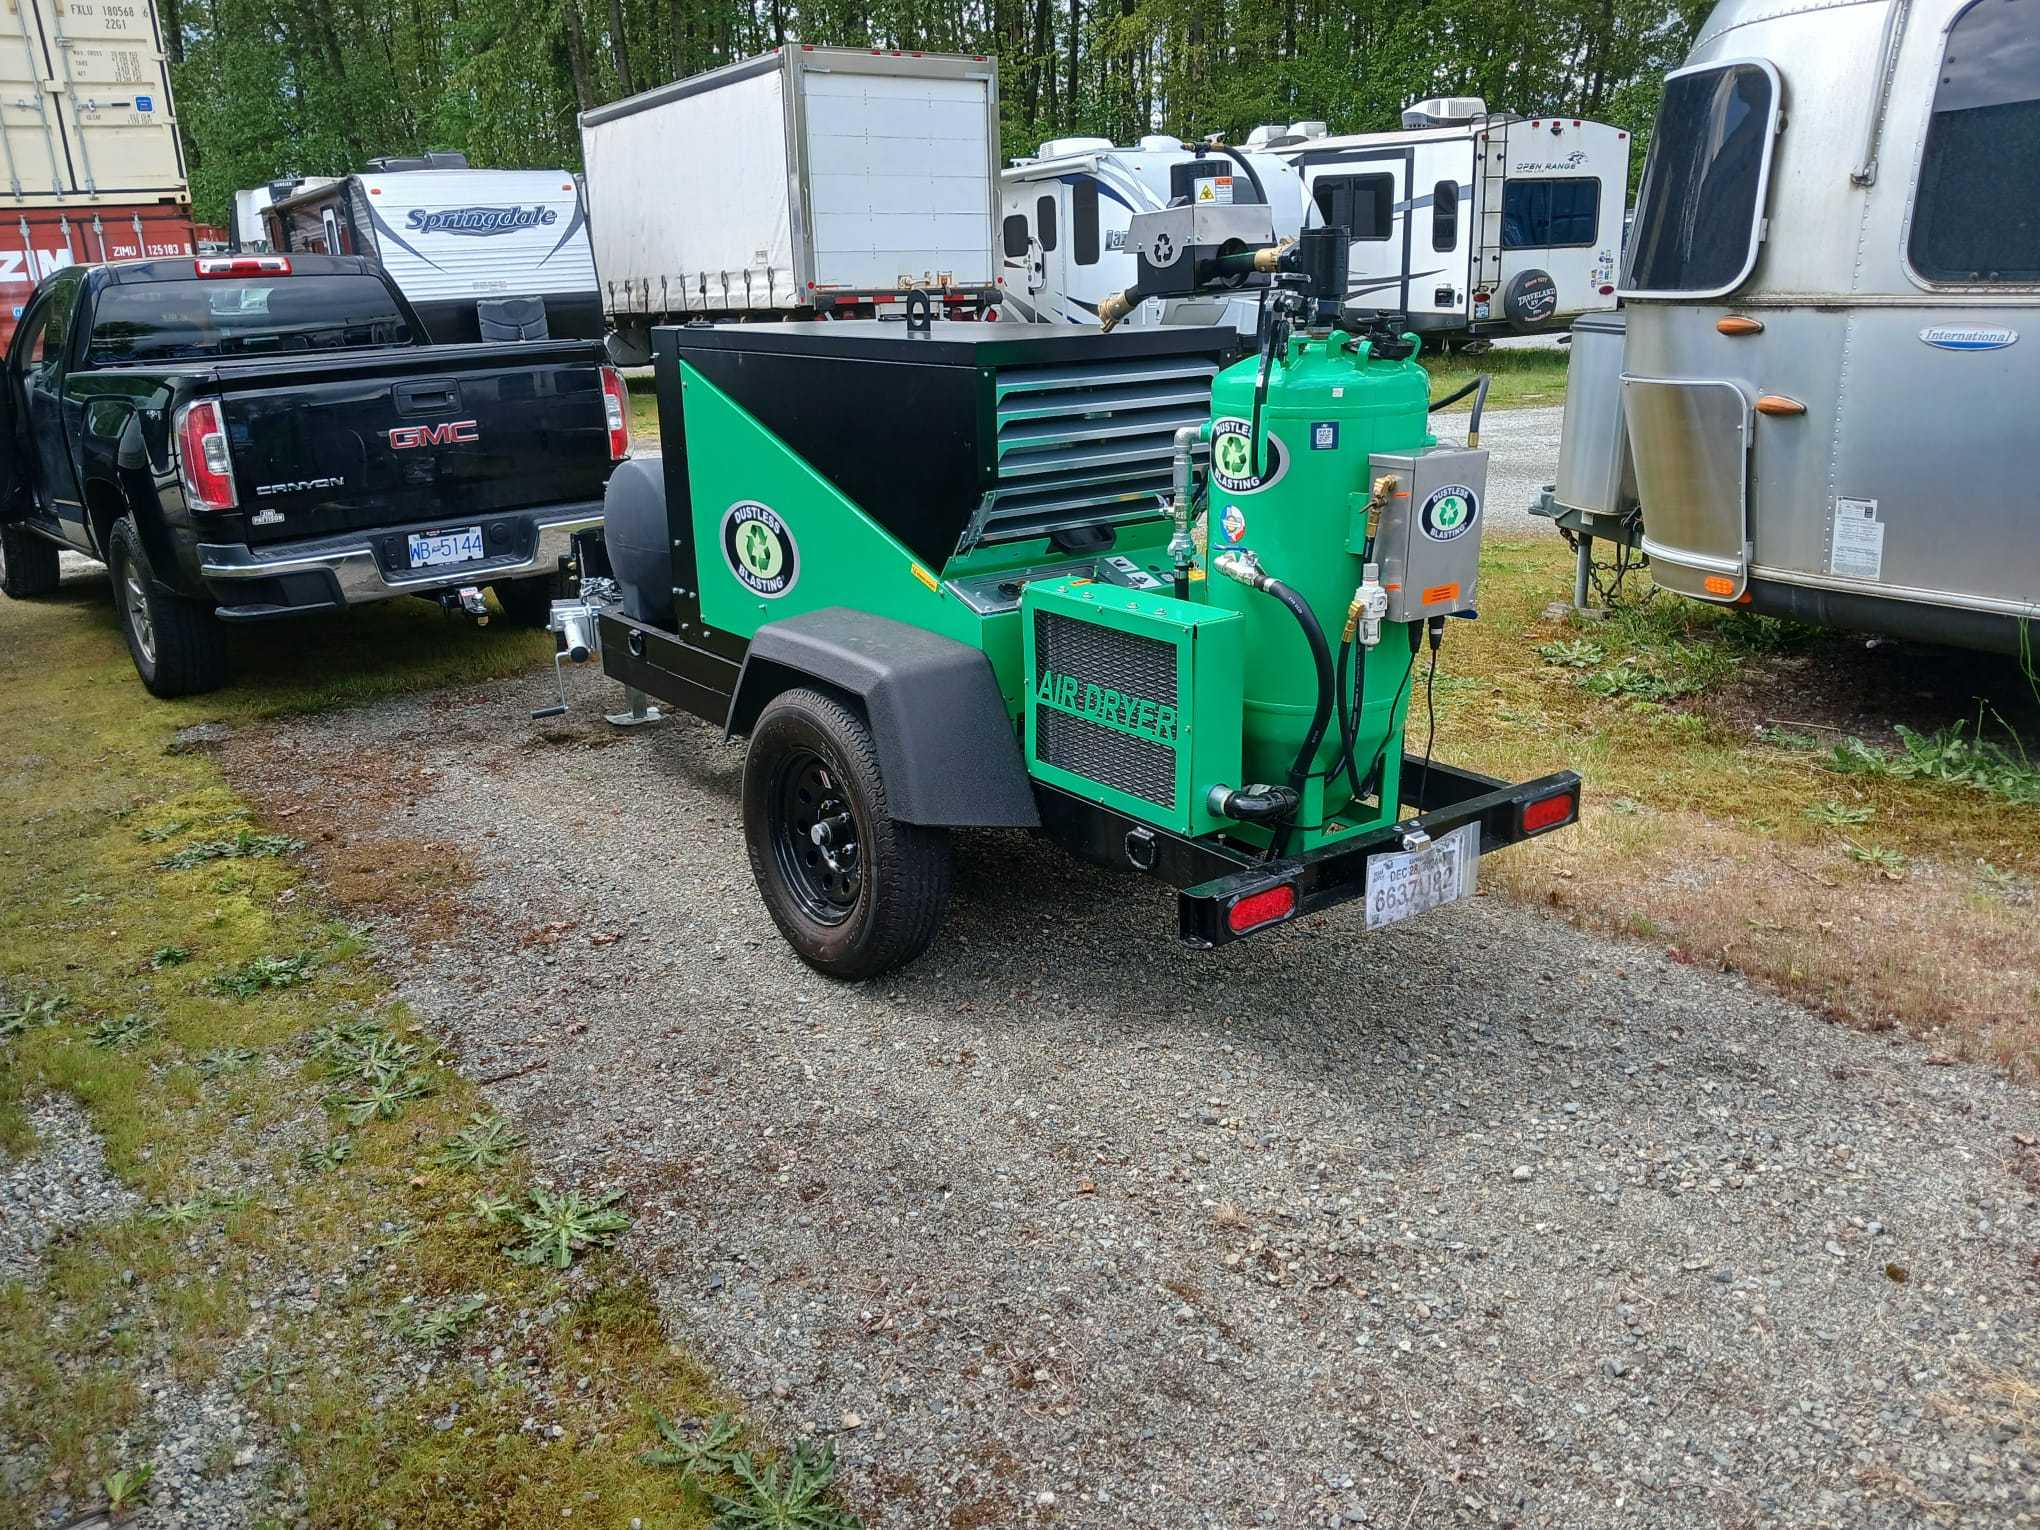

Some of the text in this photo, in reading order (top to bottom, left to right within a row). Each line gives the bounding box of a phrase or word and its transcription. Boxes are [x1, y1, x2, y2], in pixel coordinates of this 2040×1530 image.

[70, 4, 149, 18] FXLU 180568 6
[105, 19, 126, 30] 22G1
[1516, 161, 1577, 170] OPEN RANGE
[405, 205, 557, 234] Springdale
[112, 246, 137, 257] ZIMU
[147, 244, 179, 256] 125183
[1517, 287, 1556, 307] TRAVELAND
[1926, 329, 2012, 342] International
[388, 419, 480, 449] GMC
[255, 476, 345, 495] CANYON
[1432, 487, 1469, 503] DUSTLESS
[734, 506, 781, 534] DUSTLESS
[738, 564, 784, 592] BLASTING
[1037, 670, 1178, 743] AIR DRYER
[1390, 868, 1408, 882] DEC
